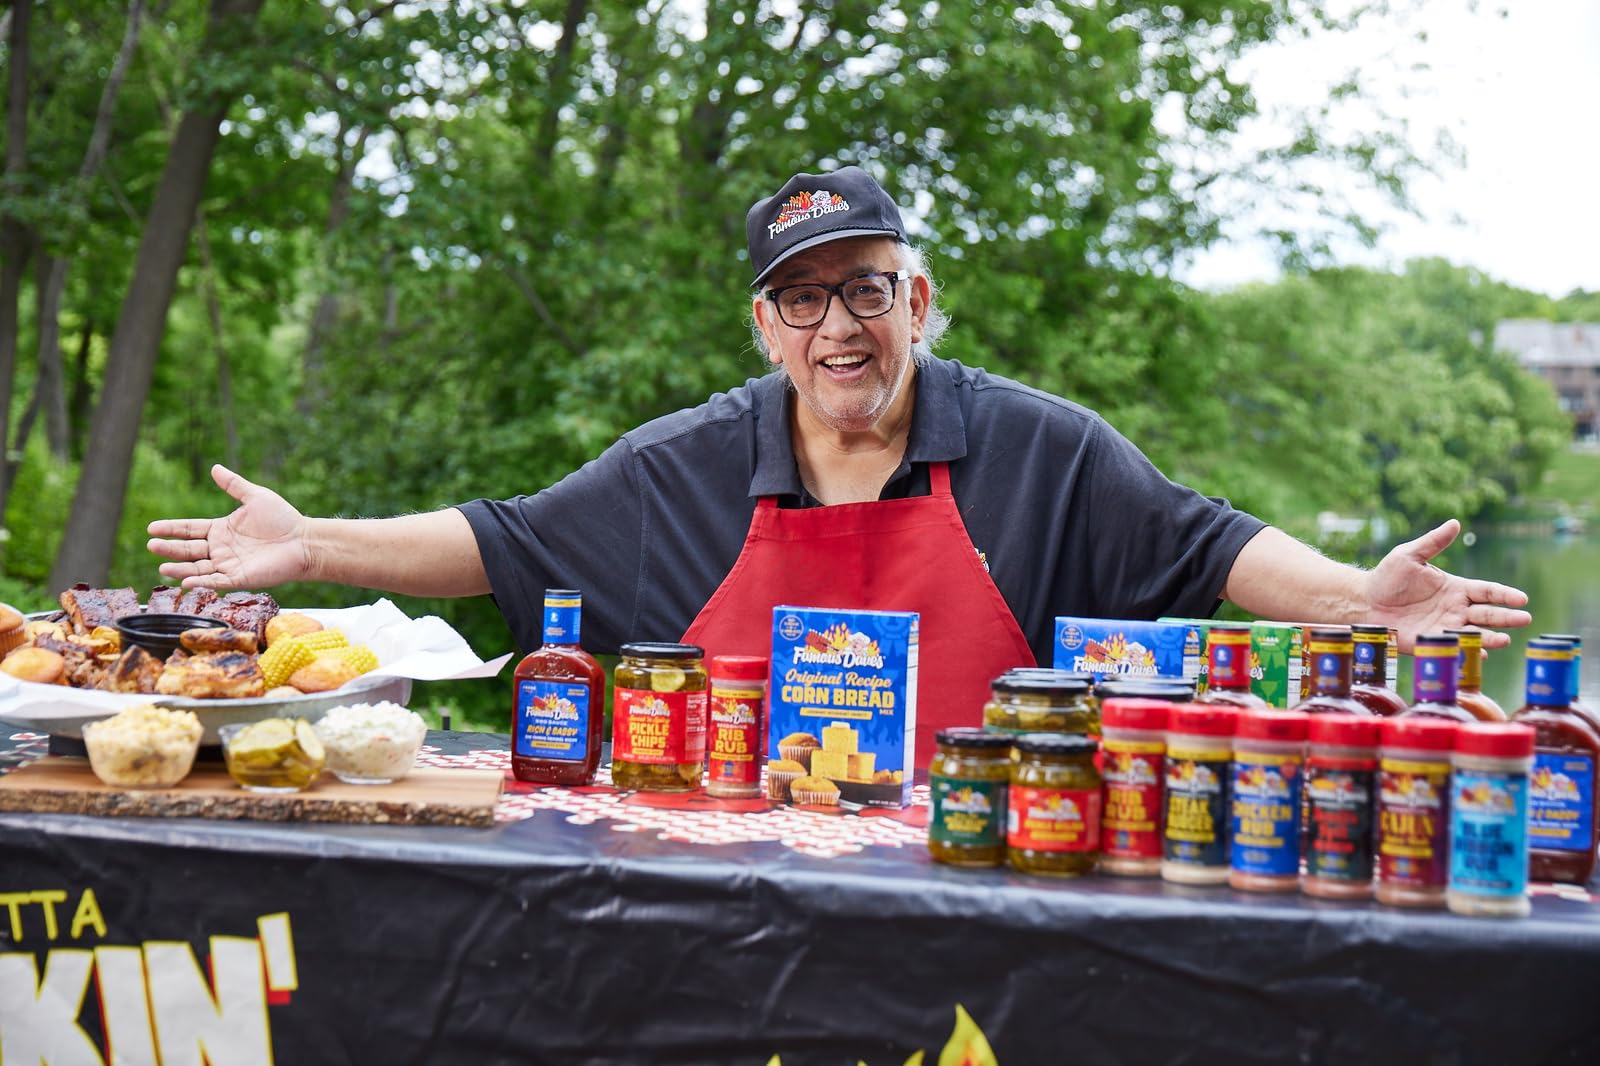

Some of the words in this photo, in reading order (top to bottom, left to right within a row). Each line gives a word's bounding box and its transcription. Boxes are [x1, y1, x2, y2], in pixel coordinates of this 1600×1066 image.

[767, 212, 811, 240] Famous
[793, 646, 842, 665] Famous
[843, 649, 885, 669] Dave's
[1073, 656, 1119, 675] Famous
[785, 669, 843, 688] Original
[845, 672, 893, 690] Recipe
[781, 686, 829, 705] CORN
[832, 688, 895, 709] BREAD
[878, 708, 894, 716] MIX
[527, 725, 545, 734] RICH
[629, 722, 670, 736] PICKLE
[718, 728, 745, 742] RIB
[631, 734, 667, 748] CHIPS
[714, 739, 747, 754] RUB
[1105, 803, 1147, 821] RUB
